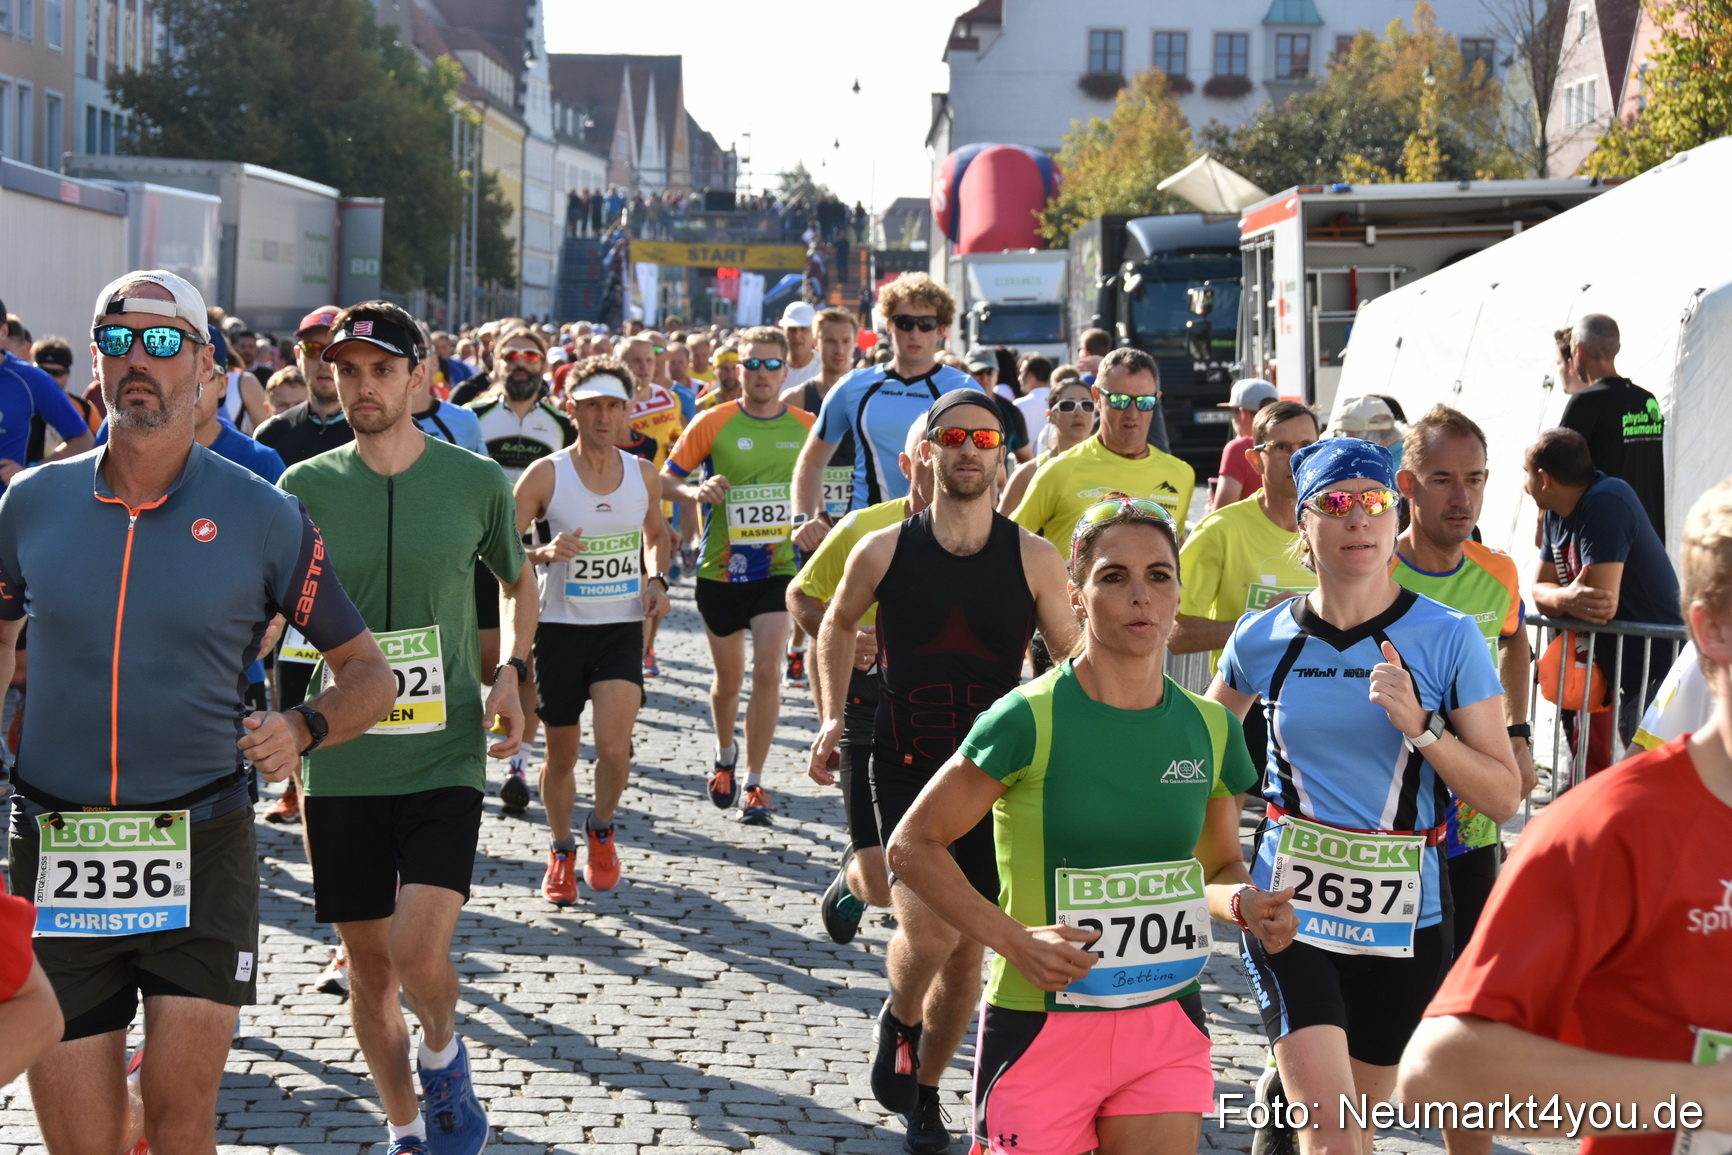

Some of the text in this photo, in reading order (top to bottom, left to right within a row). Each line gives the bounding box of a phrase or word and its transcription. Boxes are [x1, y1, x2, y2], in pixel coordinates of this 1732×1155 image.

[687, 247, 748, 263] START
[1622, 411, 1649, 428] physio
[1623, 422, 1662, 437] neumarkt
[500, 441, 543, 455] RADAU
[731, 485, 787, 502] BOCK
[735, 504, 786, 525] 1282
[741, 527, 782, 538] RASMUS
[575, 555, 633, 579] 2504
[578, 582, 628, 596] THOMAS
[1475, 611, 1498, 623] OCK
[374, 632, 431, 660] CK
[380, 708, 414, 722] EN
[1161, 759, 1206, 779] AOK
[50, 817, 177, 848] BOCK
[1288, 825, 1411, 868] BOCK
[53, 858, 172, 900] 2336
[1068, 865, 1197, 906] BOCK
[1291, 864, 1403, 916] 2637
[54, 912, 169, 931] CHRISTOF
[1304, 917, 1376, 943] ANIKA
[1077, 910, 1197, 959] 2704
[1111, 968, 1178, 988] Bettina
